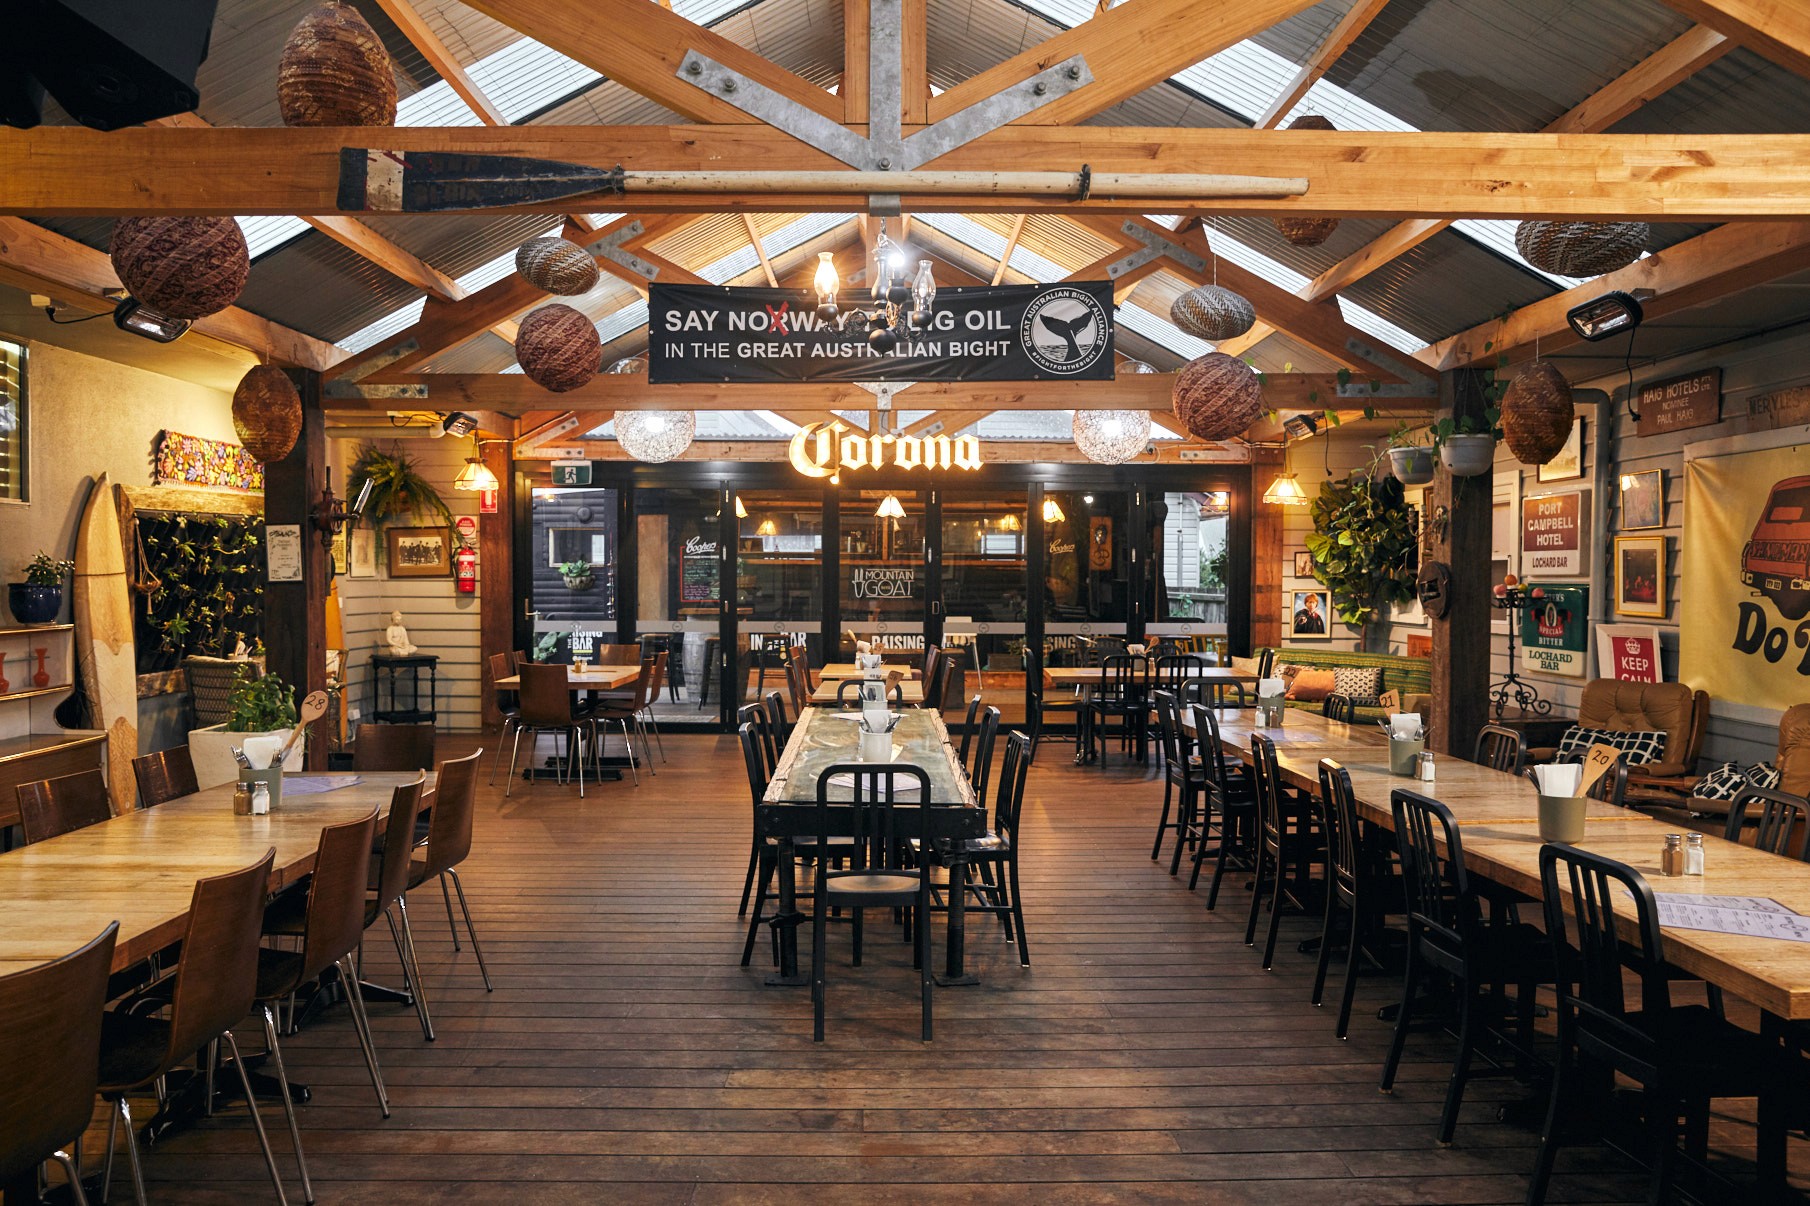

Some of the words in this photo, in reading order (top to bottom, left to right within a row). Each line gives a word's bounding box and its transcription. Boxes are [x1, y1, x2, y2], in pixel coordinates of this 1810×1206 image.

[1027, 291, 1070, 319] AUSTRALIAN
[1071, 291, 1094, 307] BIGHT
[665, 309, 719, 331] SAY
[964, 309, 1012, 330] OIL
[1091, 306, 1105, 346] ALLIANCE
[1023, 320, 1032, 347] GREAT
[665, 343, 684, 358] IN
[690, 343, 730, 358] THE
[737, 342, 805, 358] GREAT
[950, 340, 1011, 356] BIGHT
[1643, 387, 1663, 404] HAIG
[1666, 378, 1700, 400] HOTELS
[1657, 413, 1673, 426] PAUL
[1676, 408, 1694, 422] HAIG
[788, 419, 984, 484] Corona
[1538, 501, 1563, 516] PORT
[1527, 516, 1574, 531] CAMPBELL
[1536, 533, 1564, 546] HOTEL
[1532, 557, 1556, 568] LOCHARD
[1557, 556, 1568, 568] BAR
[865, 570, 914, 580] MOUNTAIN
[865, 580, 914, 596] GOAT
[573, 637, 594, 650] BAR
[1538, 637, 1564, 647] BITTER
[1529, 650, 1573, 663] LOCHARD
[1622, 656, 1649, 671] KEEP
[1540, 660, 1560, 671] BAR
[305, 694, 326, 711] 28
[1381, 695, 1395, 708] 21
[1592, 749, 1610, 765] 20
